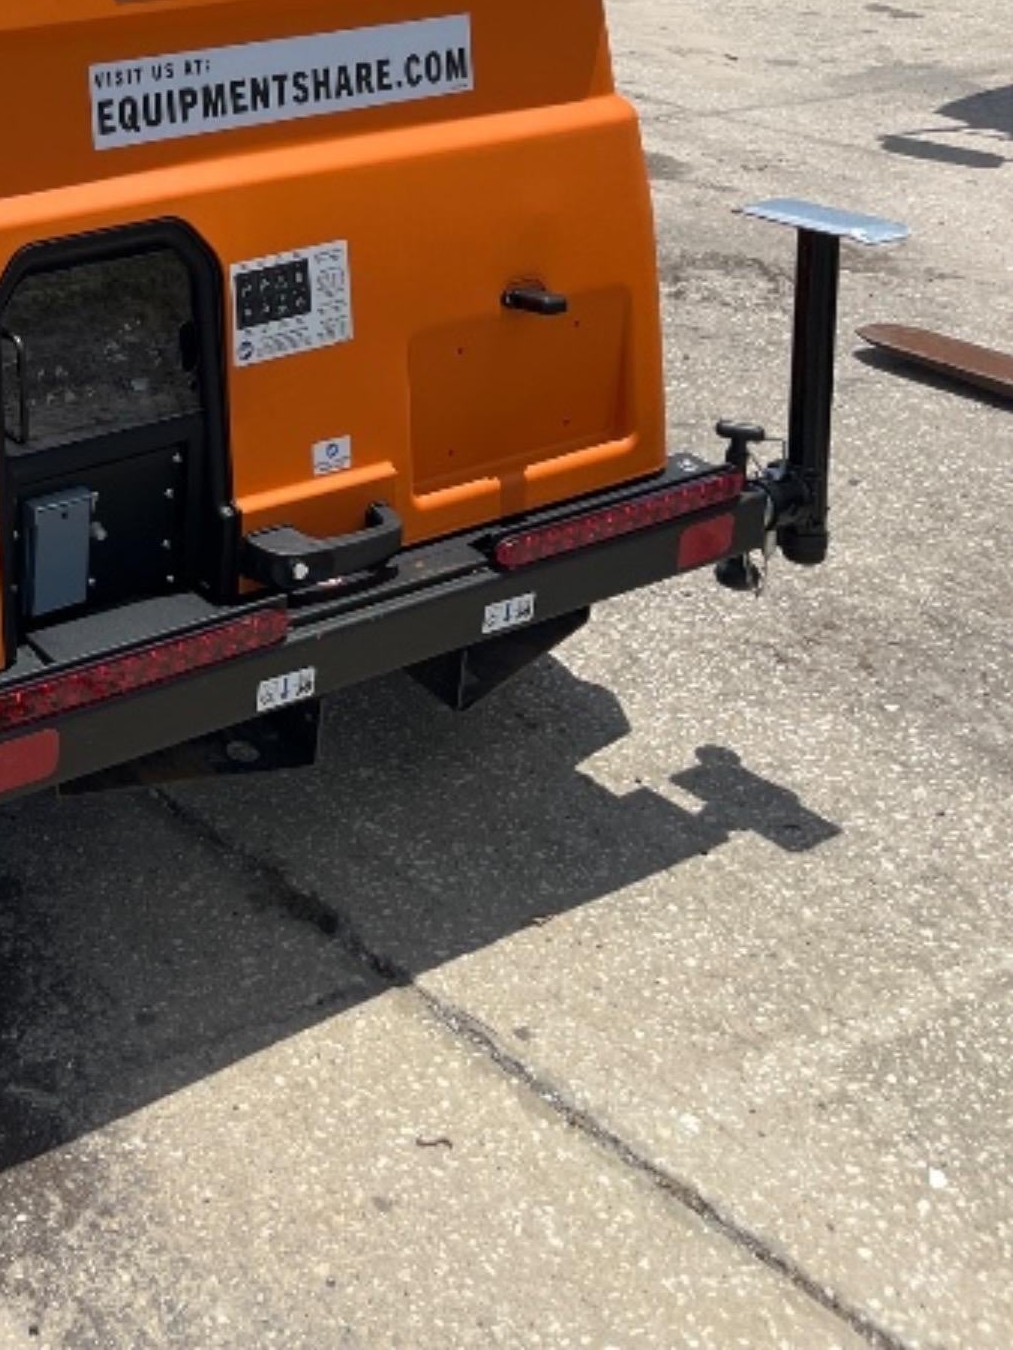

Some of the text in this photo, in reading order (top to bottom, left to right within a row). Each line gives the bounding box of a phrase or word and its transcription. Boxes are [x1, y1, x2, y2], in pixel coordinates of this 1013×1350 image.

[94, 58, 211, 89] VISIT US AT:
[97, 47, 469, 136] EQUIPMENTSHARE.COM
